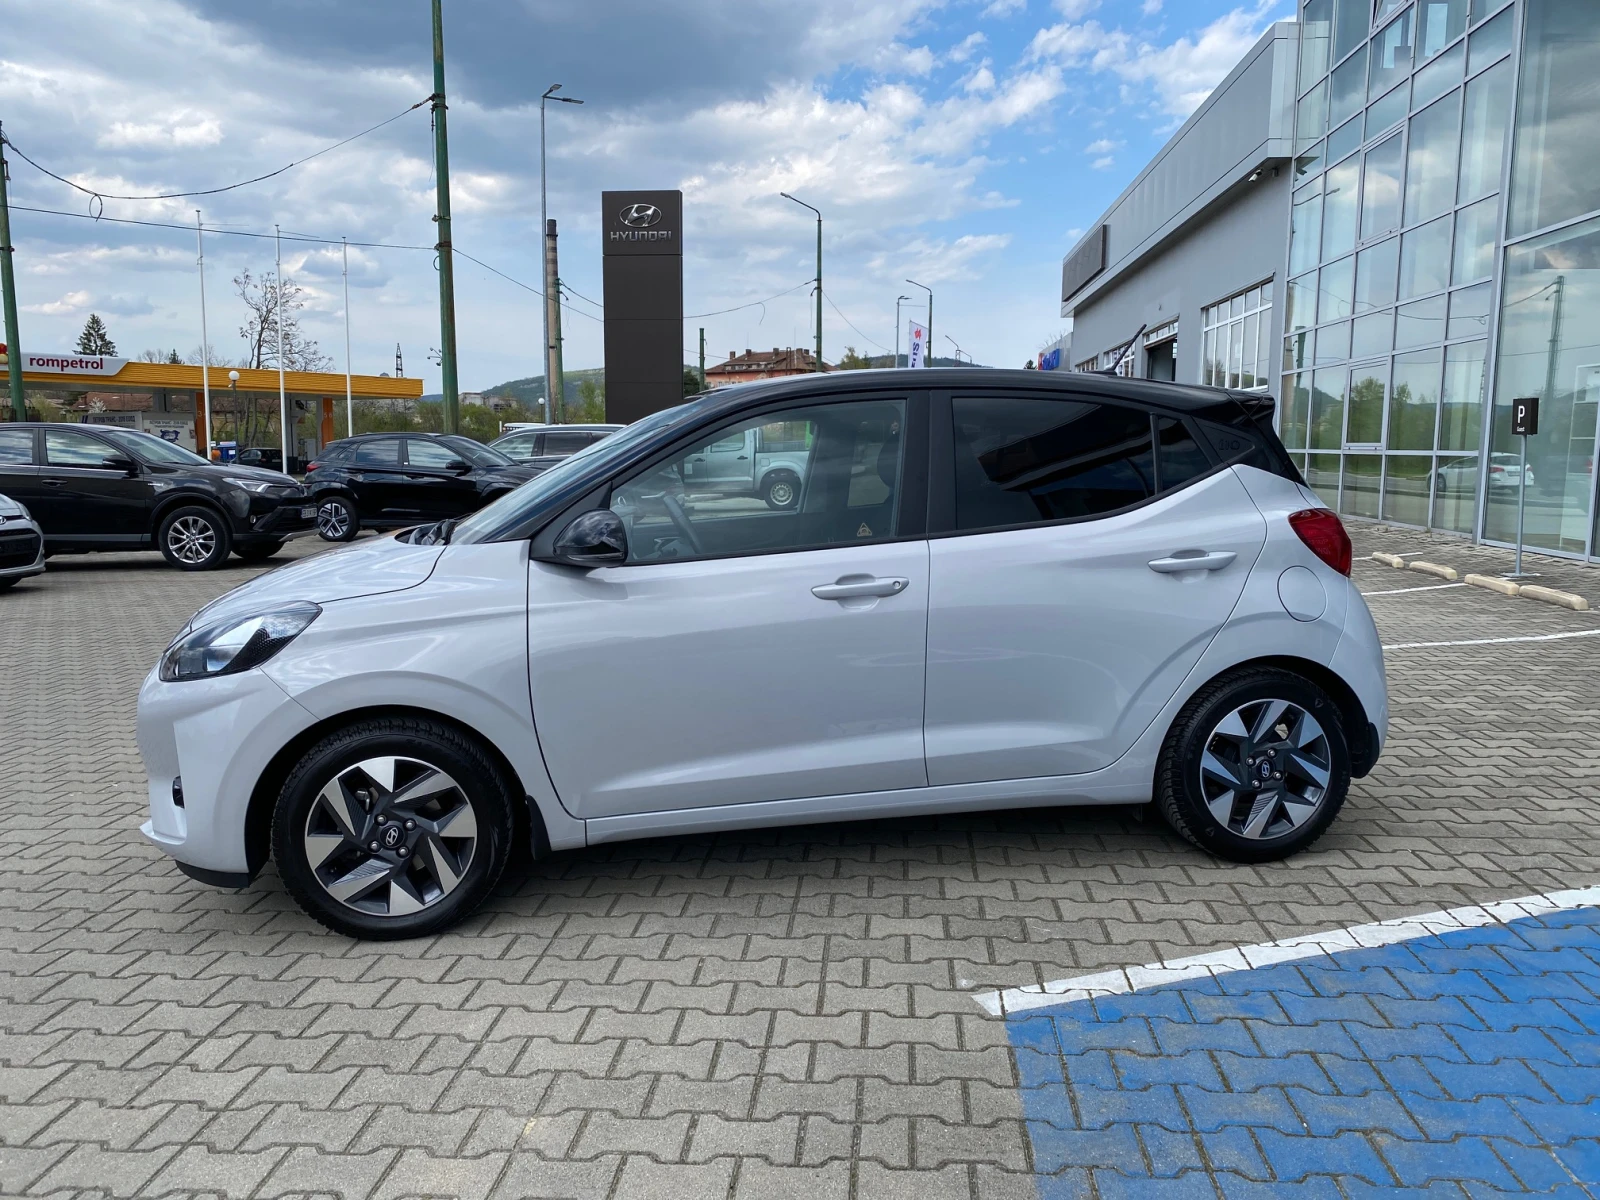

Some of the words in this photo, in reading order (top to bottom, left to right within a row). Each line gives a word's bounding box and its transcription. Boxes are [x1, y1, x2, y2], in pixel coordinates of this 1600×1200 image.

[610, 231, 672, 241] HYUNDAI
[29, 357, 103, 371] rompetrol
[1517, 405, 1526, 424] P
